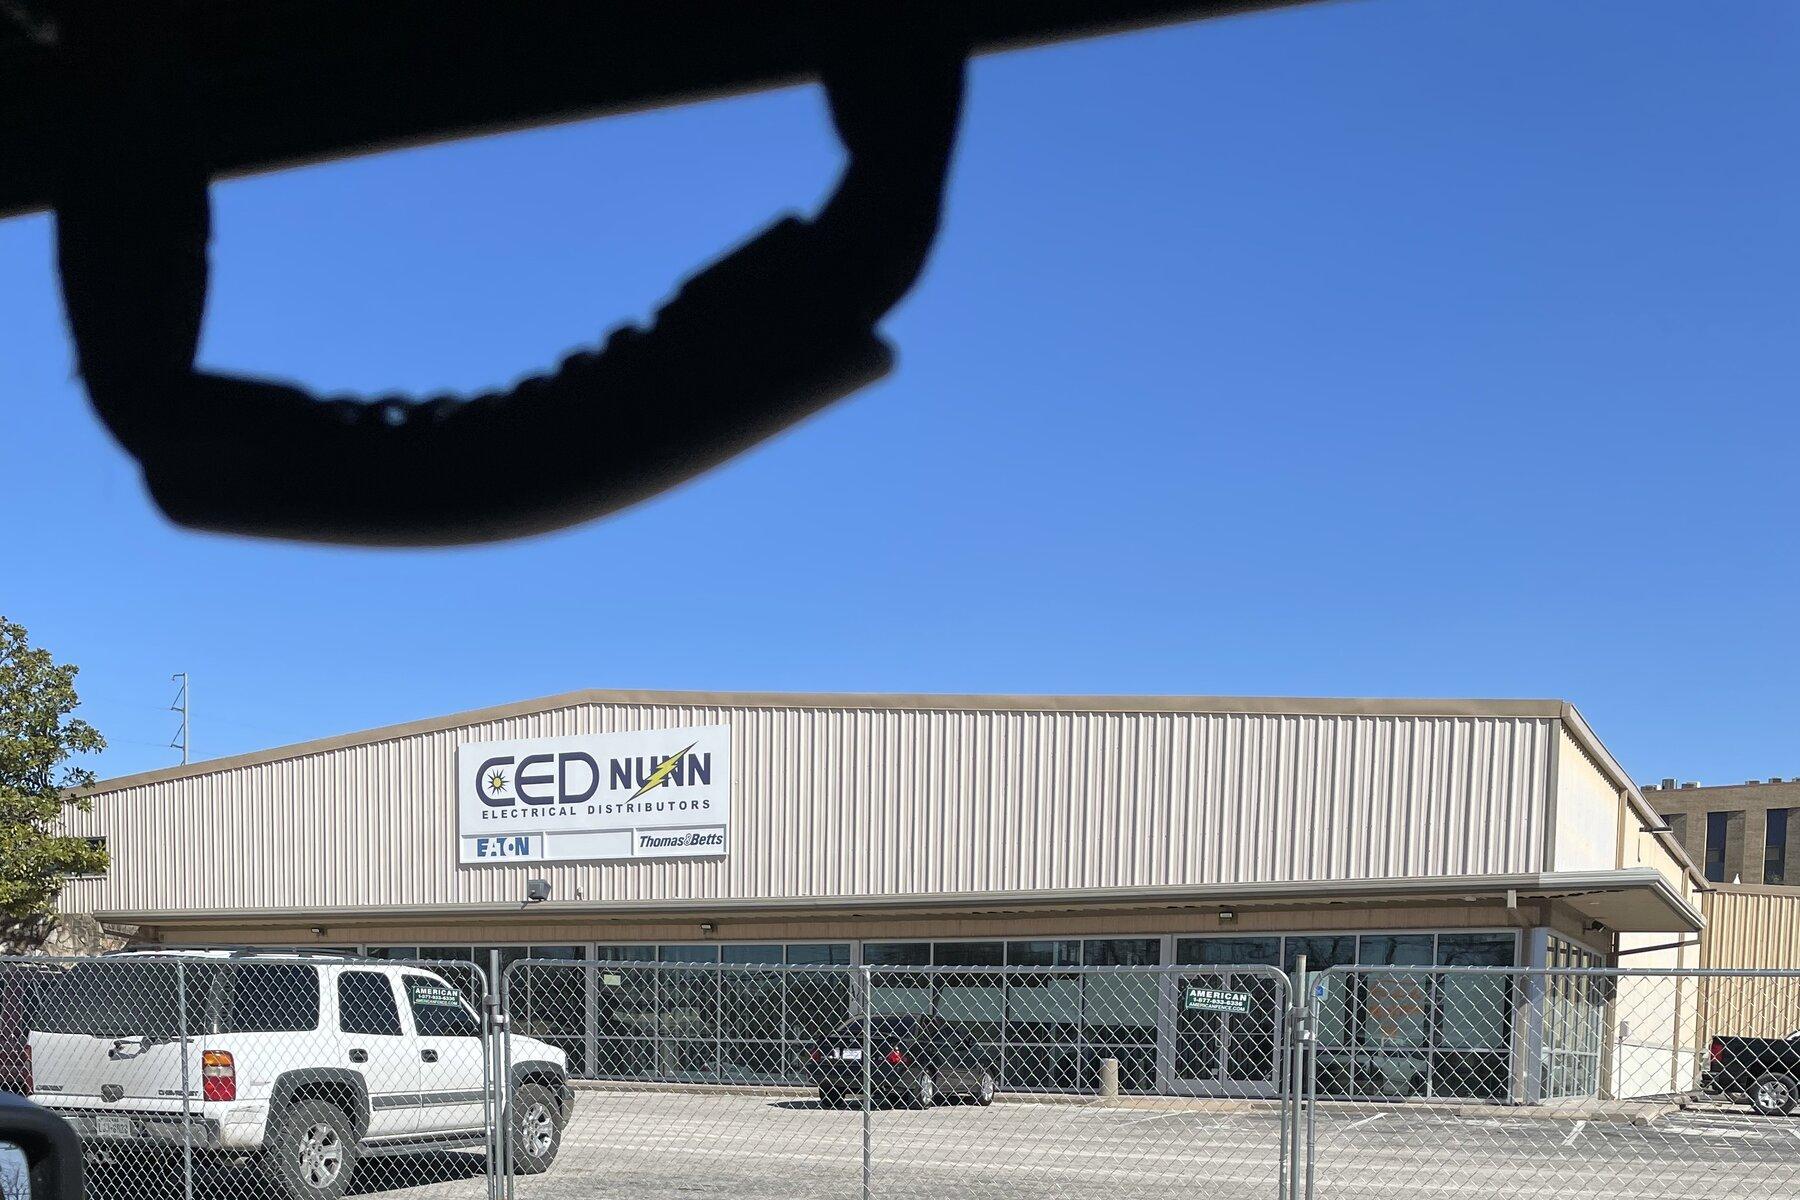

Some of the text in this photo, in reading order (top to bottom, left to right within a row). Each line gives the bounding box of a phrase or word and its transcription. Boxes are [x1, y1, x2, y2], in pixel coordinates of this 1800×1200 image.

[475, 751, 712, 807] CED NUNN
[481, 799, 711, 820] ELECTRICAL DISTRIBUTORS
[476, 837, 530, 858] EATON
[415, 988, 458, 997] AMERICAN
[1190, 990, 1247, 1001] AMERICAN
